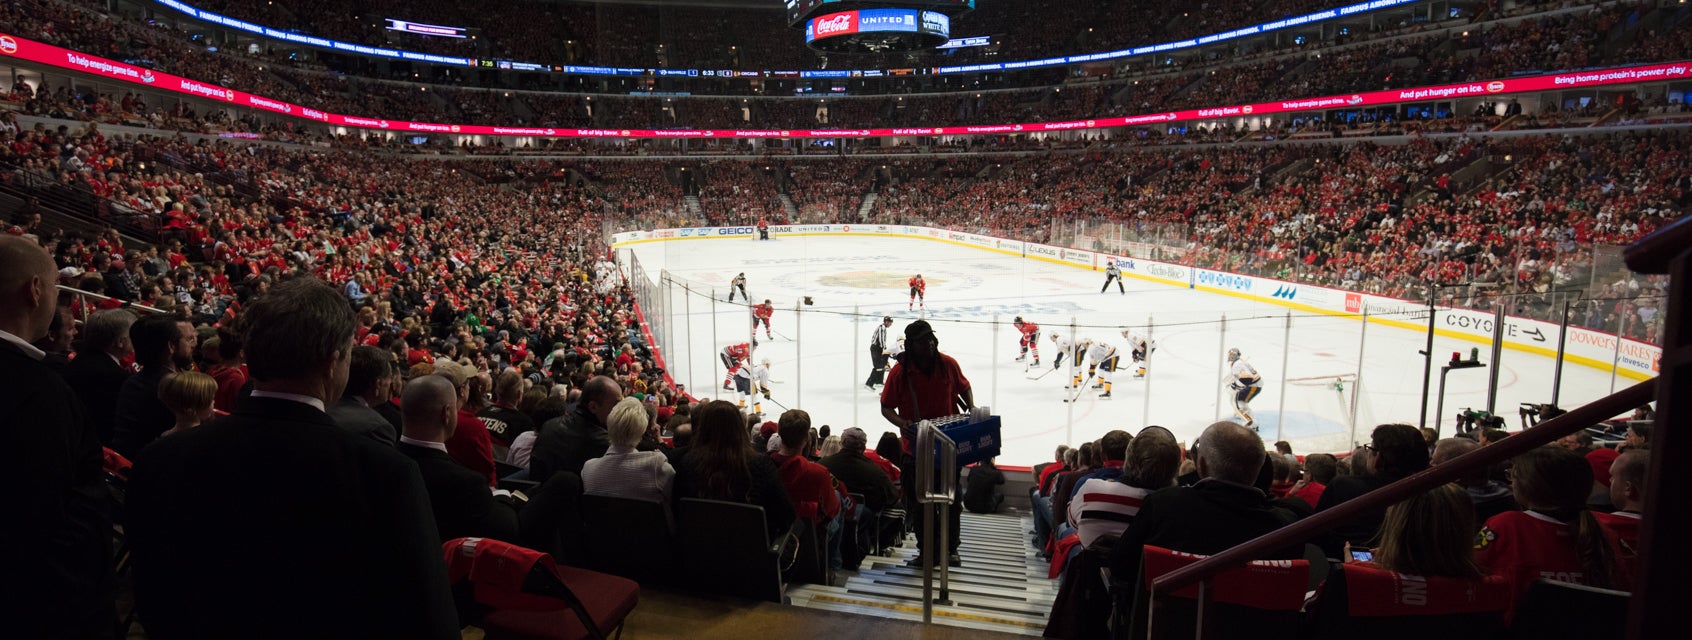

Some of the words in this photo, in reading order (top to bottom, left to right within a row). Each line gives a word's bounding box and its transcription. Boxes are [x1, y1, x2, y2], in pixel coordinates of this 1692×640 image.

[1340, 3, 1368, 14] FAMOUS
[1263, 21, 1285, 30] FAMOUS
[1286, 16, 1307, 25] AMONG
[1308, 11, 1336, 21] FRIENDS.
[67, 54, 76, 63] To
[76, 56, 89, 67] help
[90, 61, 113, 71] energize
[113, 66, 127, 74] game
[127, 68, 140, 77] time.
[1600, 71, 1635, 81] protein's
[1637, 69, 1666, 78] power
[1667, 67, 1687, 75] play
[1416, 90, 1428, 98] put
[1429, 88, 1456, 96] hunger
[719, 227, 753, 235] GEICO
[1116, 258, 1135, 269] bank
[1446, 314, 1518, 337] COYOE
[1622, 355, 1650, 369] invesco
[477, 416, 508, 434] TENS
